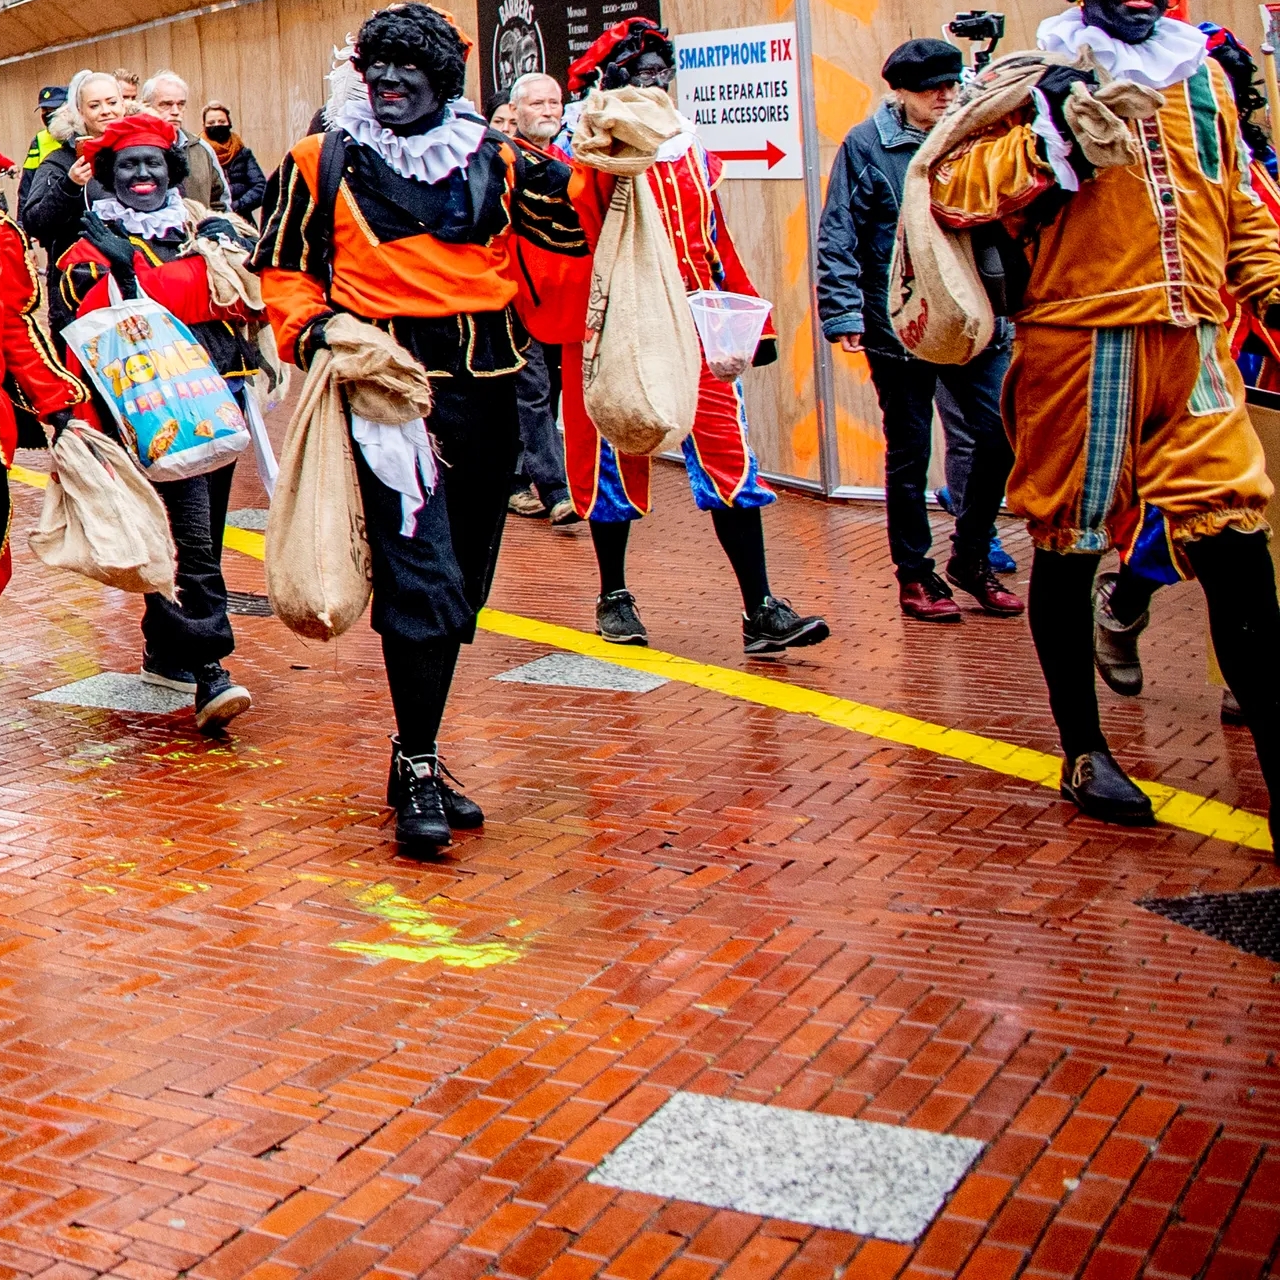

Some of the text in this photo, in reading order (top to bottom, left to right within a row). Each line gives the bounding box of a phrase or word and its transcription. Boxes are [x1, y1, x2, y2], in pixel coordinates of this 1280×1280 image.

[679, 38, 792, 70] SMARTPHONE FIX
[693, 80, 788, 102] ALLE REPARATIES
[695, 104, 789, 125] ALLE ACCESSOIRES
